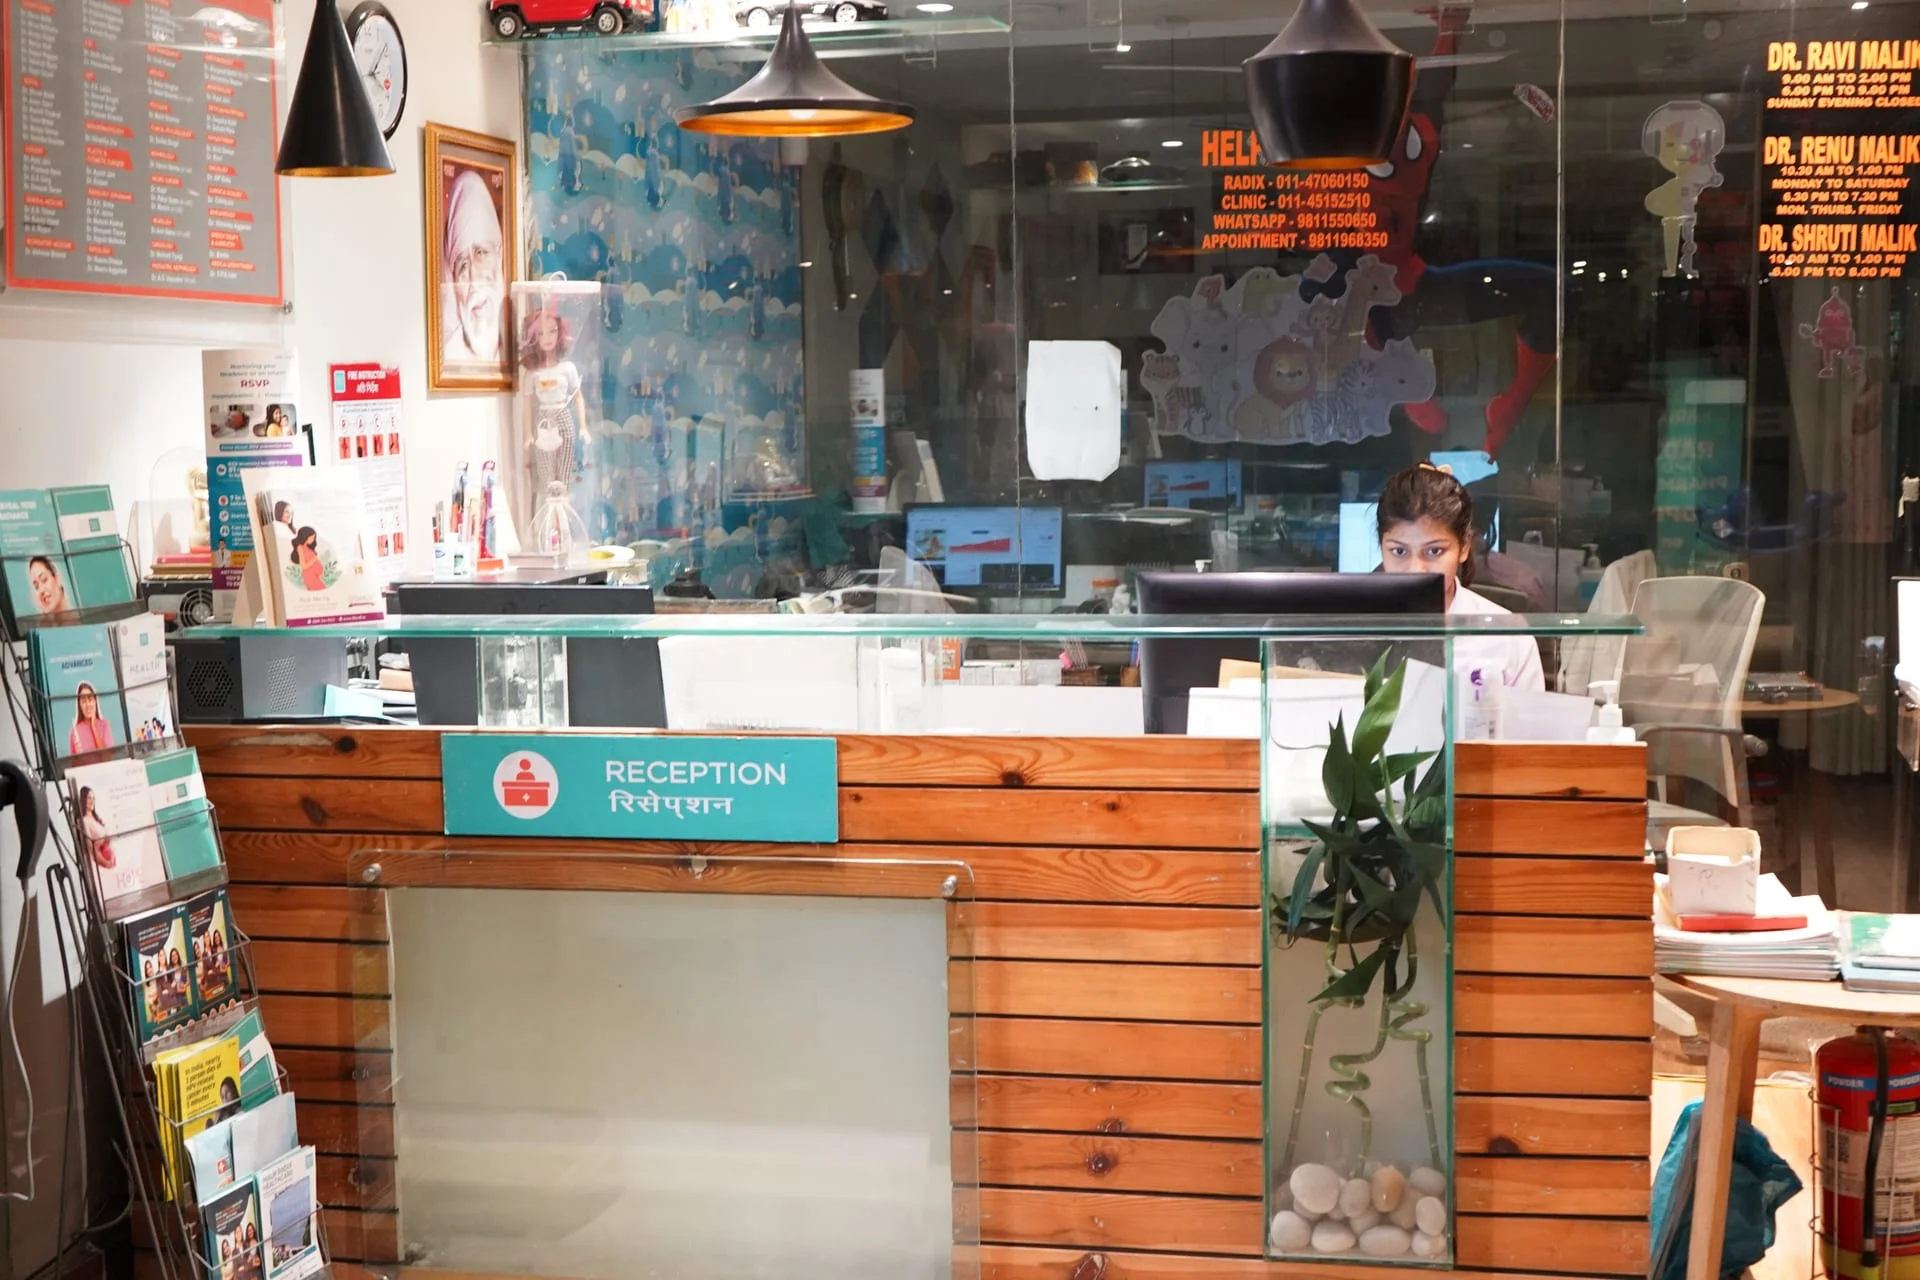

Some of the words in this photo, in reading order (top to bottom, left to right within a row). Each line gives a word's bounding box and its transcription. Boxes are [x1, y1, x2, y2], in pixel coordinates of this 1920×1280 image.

[1768, 41, 1802, 71] DR.
[1807, 41, 1856, 70] RAVI
[1782, 73, 1811, 85] 9.00
[1813, 73, 1835, 84] AM
[1836, 73, 1857, 84] TO
[1858, 72, 1888, 84] 2.00
[1890, 72, 1912, 83] PM
[1781, 85, 1811, 96] 6.00
[1812, 85, 1834, 96] PM
[1835, 85, 1856, 96] TO
[1857, 85, 1887, 96] 9.00
[1889, 84, 1911, 95] PM
[1767, 98, 1816, 109] SUNDAY
[1817, 97, 1873, 108] EVENING
[1764, 136, 1796, 165] DR.
[1800, 136, 1855, 164] RENU
[1859, 135, 1920, 164] MALIK
[1780, 165, 1813, 176] 10.30
[1814, 165, 1835, 176] AM
[1836, 165, 1854, 176] TO
[1856, 165, 1883, 176] 1.00
[1884, 165, 1904, 175] PM
[1224, 175, 1265, 190] RADIX
[1276, 173, 1369, 190] 011-47060150
[1771, 178, 1824, 189] MONDAY
[1825, 178, 1844, 189] TO
[1845, 177, 1910, 189] SATURDAY
[1221, 195, 1267, 210] CLINIC
[1278, 193, 1371, 209] 011-45152510
[1782, 191, 1809, 202] 6.30
[1810, 191, 1830, 202] PM
[1831, 191, 1849, 202] TO
[1850, 191, 1878, 202] 7.30
[1879, 191, 1899, 201] PM
[1776, 204, 1808, 215] MON.
[1810, 204, 1857, 215] THURS.
[1858, 204, 1903, 215] FRIDAY
[1213, 213, 1286, 230] WHATSAPP
[1297, 212, 1377, 229] 9811550650
[1202, 233, 1298, 249] APPOINTMENT
[1309, 232, 1388, 248] 9811968350
[1759, 224, 1788, 251] DR.
[1791, 223, 1857, 252] SHRUTI
[1861, 223, 1918, 251] MALIK
[1807, 254, 1829, 264] AM
[1831, 254, 1850, 264] TO
[1853, 254, 1884, 264] 1.00
[1885, 253, 1906, 264] PM
[1803, 266, 1824, 277] PM
[1826, 266, 1846, 277] TO
[1880, 266, 1902, 277] PM
[605, 760, 786, 785] RECEPTION
[608, 789, 735, 819] रिसेप्शन
[1827, 1076, 1865, 1088] POWDER
